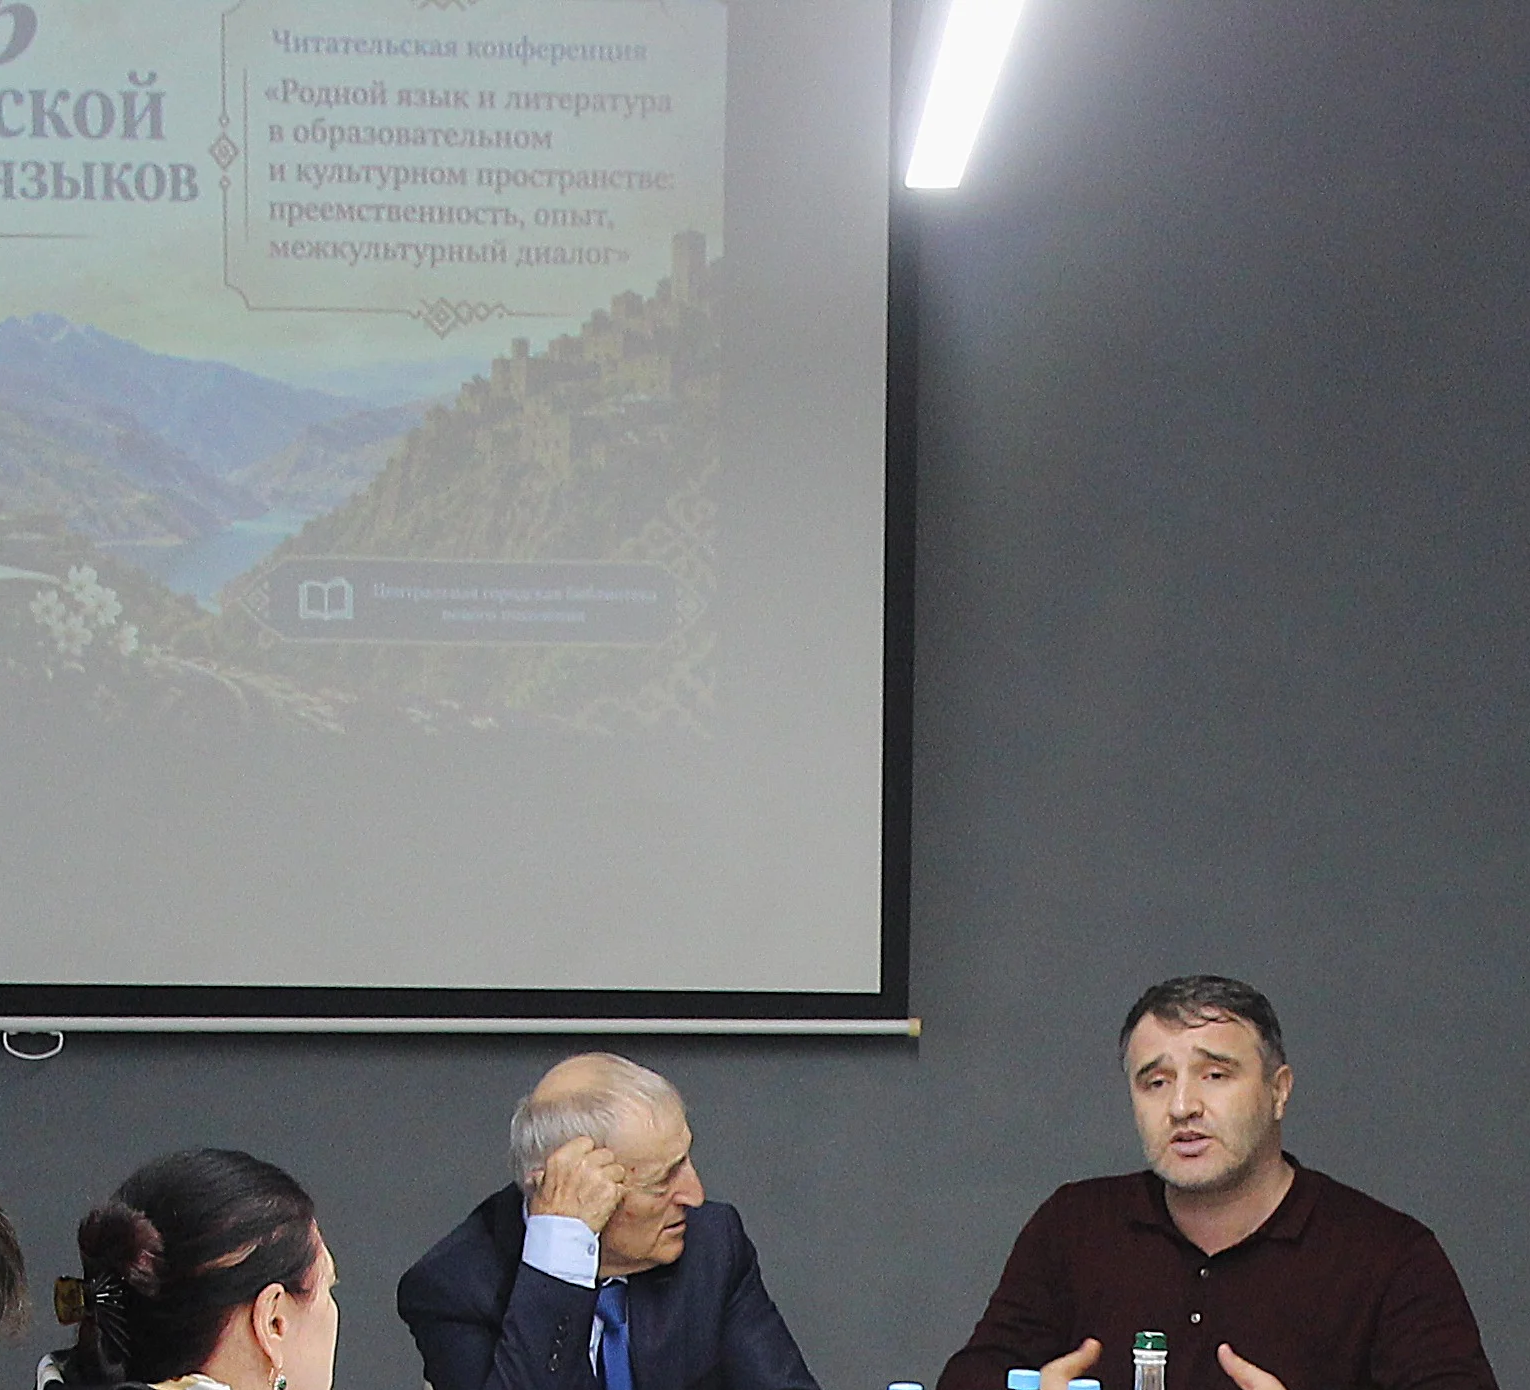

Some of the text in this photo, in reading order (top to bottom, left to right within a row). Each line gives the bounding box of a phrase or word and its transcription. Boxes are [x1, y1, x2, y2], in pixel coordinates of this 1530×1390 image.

[271, 30, 648, 66] Читательская конференция
[264, 78, 673, 117] «Родной язык и литература
[269, 118, 553, 150] в образовательном
[269, 162, 674, 193] и культурном пространстве:
[268, 200, 615, 231] преемственность, опыт,
[268, 238, 631, 268] межкультурный диалог»
